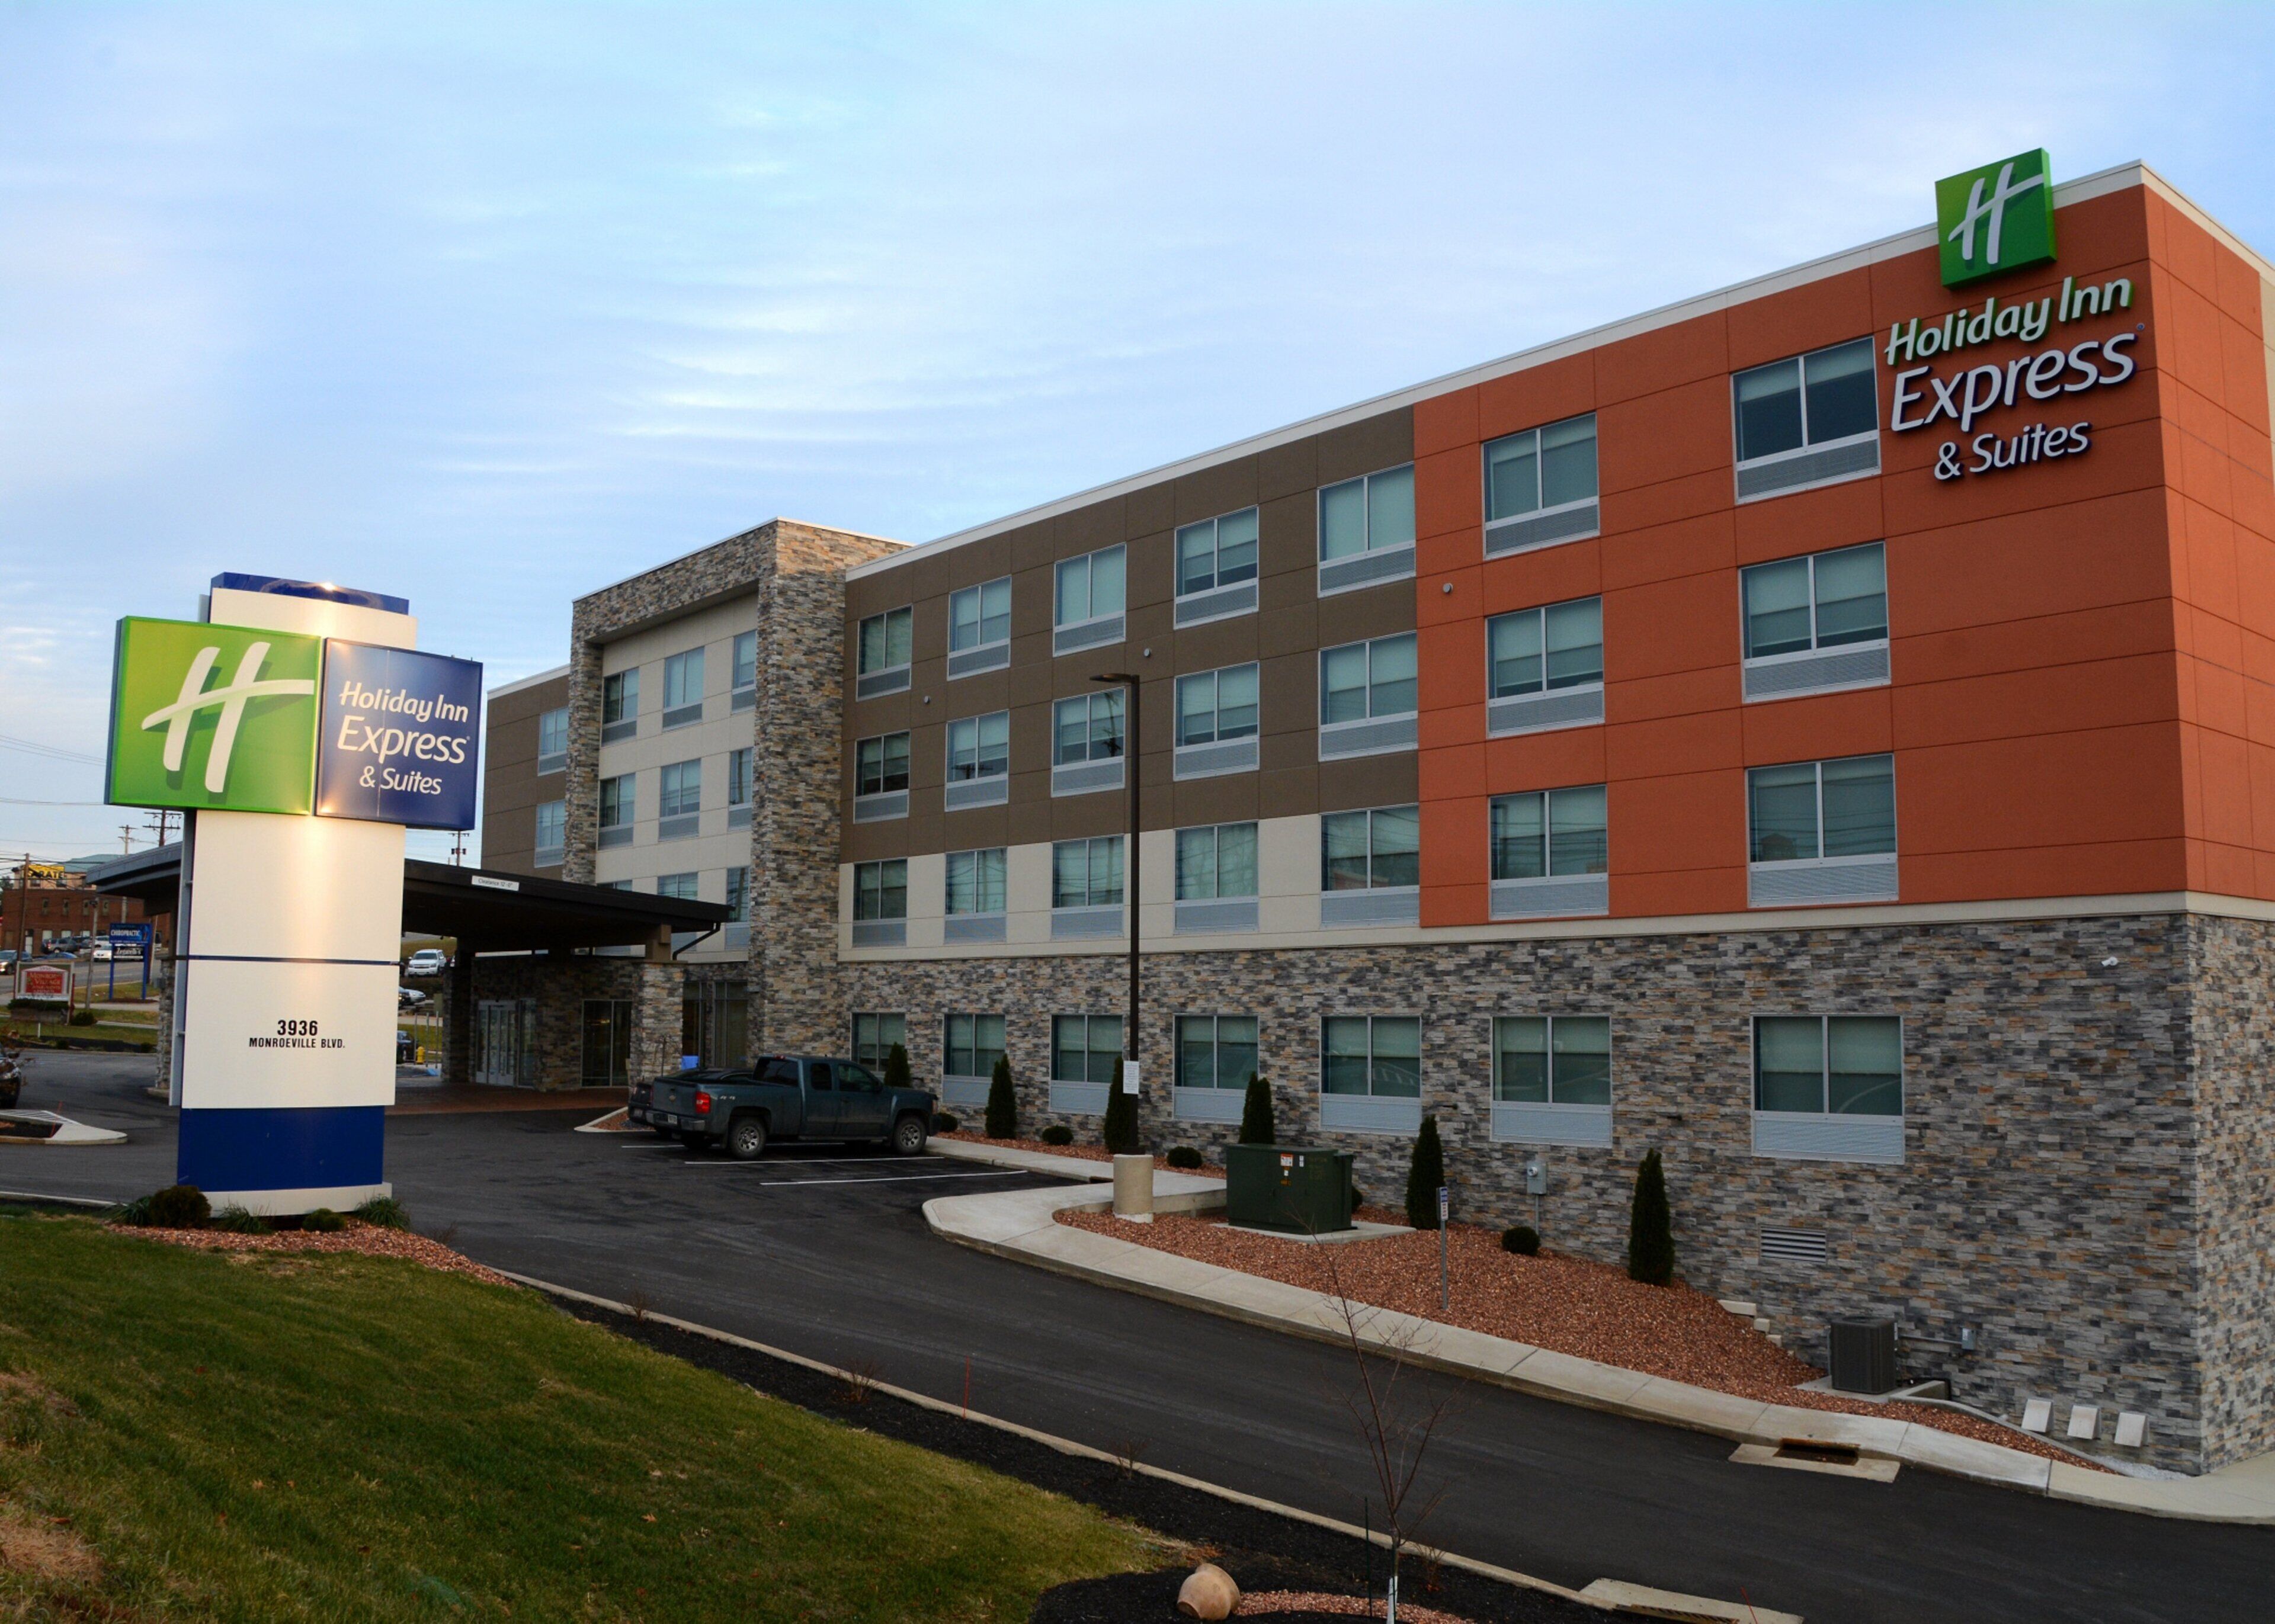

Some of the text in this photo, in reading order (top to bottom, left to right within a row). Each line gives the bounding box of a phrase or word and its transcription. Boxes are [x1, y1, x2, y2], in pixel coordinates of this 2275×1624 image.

[1884, 275, 2134, 365] Holiday Inn
[1891, 332, 2138, 432] Express
[1934, 421, 2091, 480] & Suites
[339, 680, 469, 723] Holiday Inn
[337, 714, 467, 765] Express
[359, 765, 443, 795] & Suites
[249, 1037, 345, 1049] MONROEVILLE BLVD.
[277, 1019, 318, 1036] 3936
